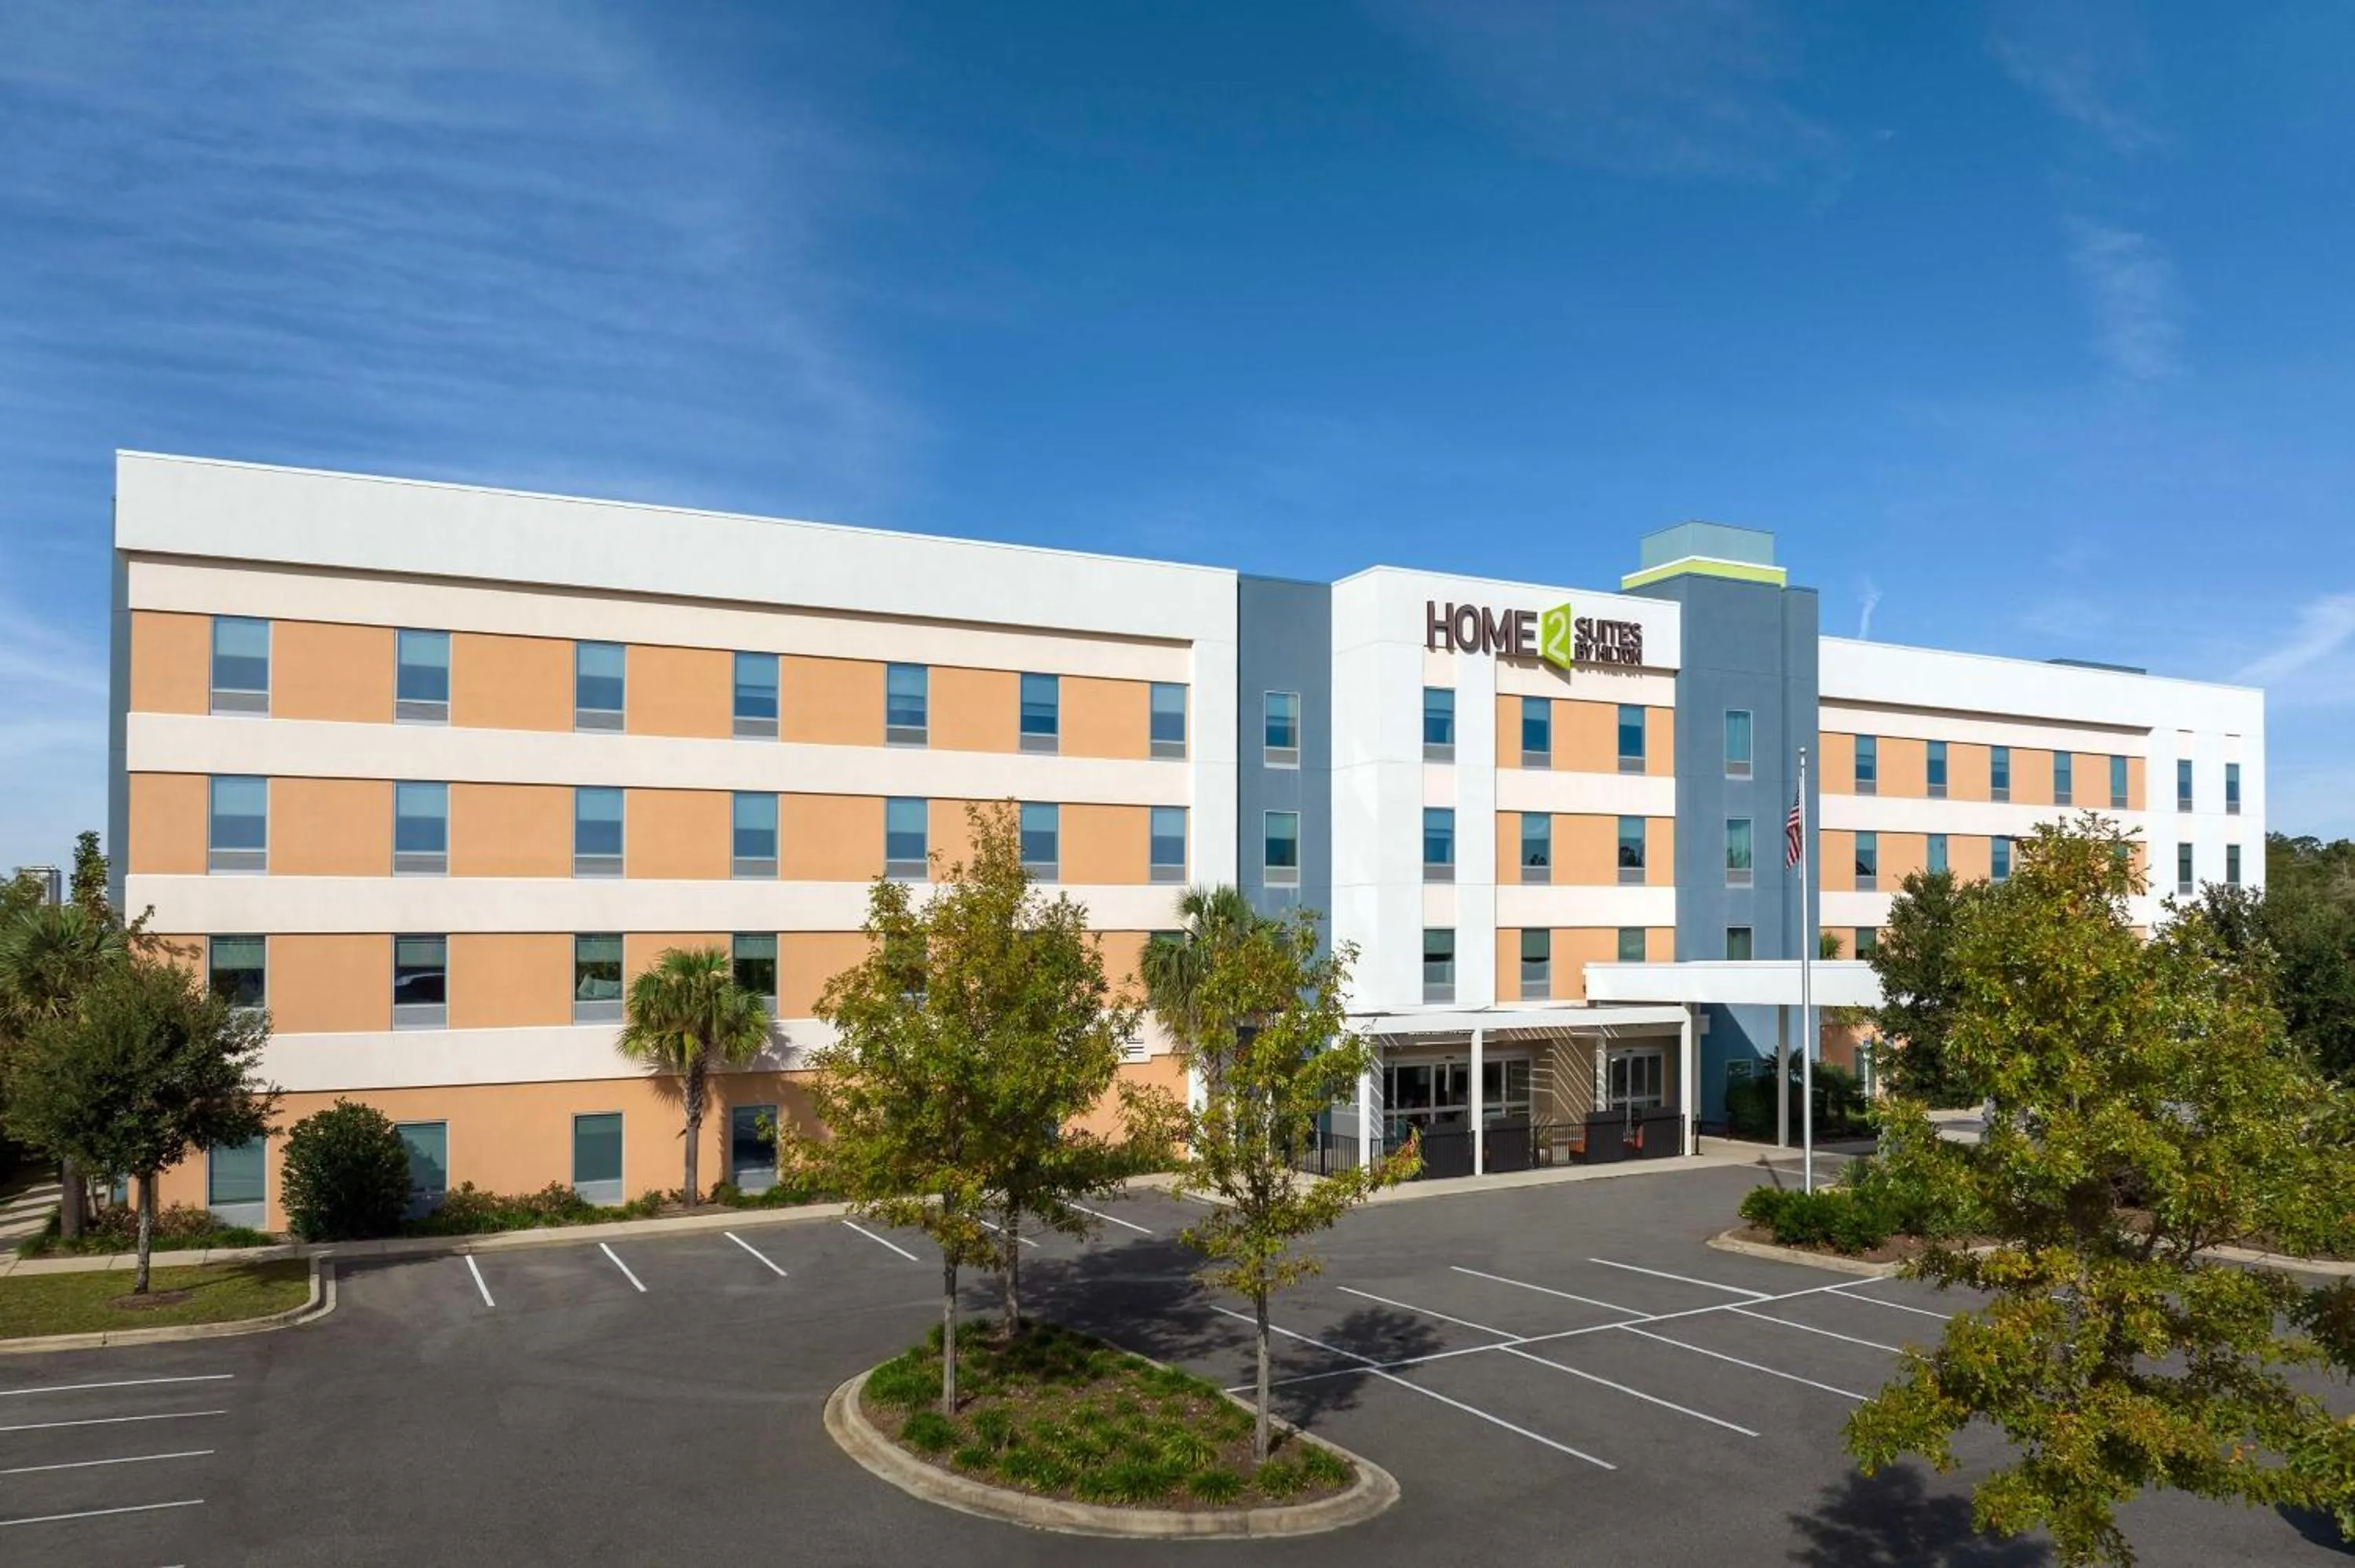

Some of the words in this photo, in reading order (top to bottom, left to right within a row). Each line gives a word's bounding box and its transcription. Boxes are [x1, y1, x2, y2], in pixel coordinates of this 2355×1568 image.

[1426, 600, 1539, 655] HOME
[1546, 611, 1568, 663] 2
[1575, 617, 1642, 647] SUITES
[1575, 643, 1594, 661] BY
[1595, 644, 1642, 665] HILTON
